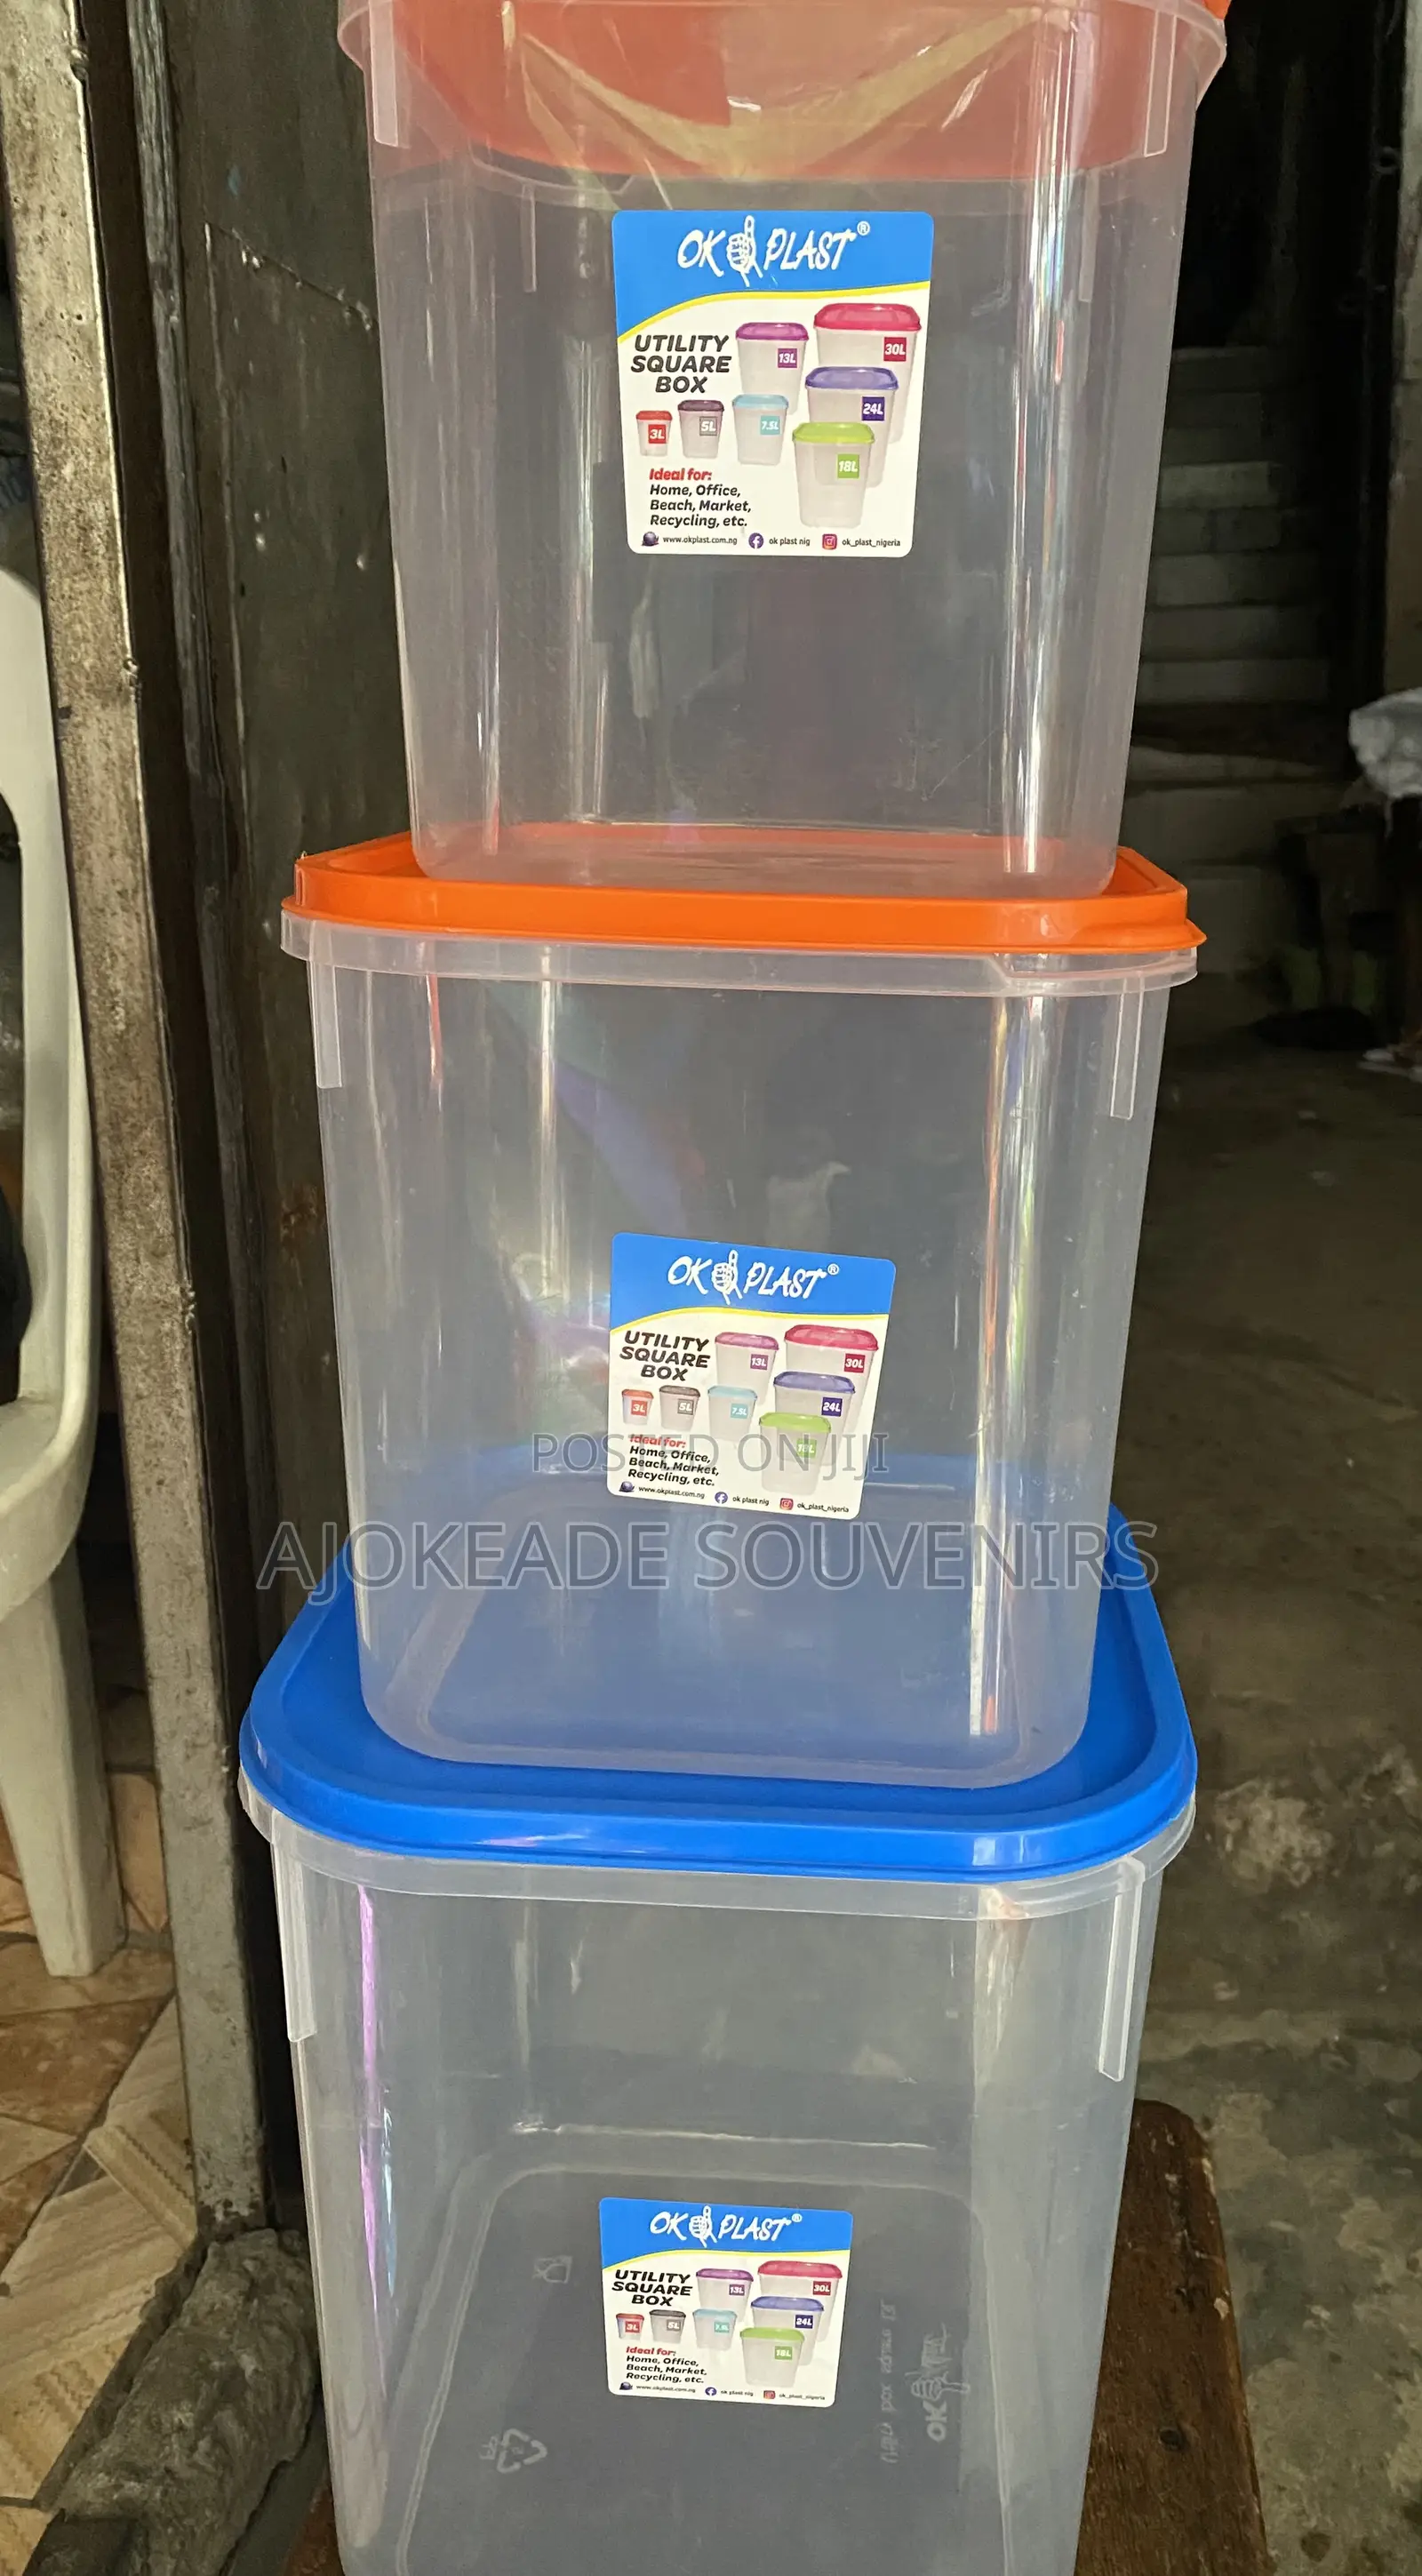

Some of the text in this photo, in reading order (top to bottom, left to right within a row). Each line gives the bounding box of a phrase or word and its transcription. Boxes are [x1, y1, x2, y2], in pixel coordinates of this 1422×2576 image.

[677, 229, 725, 277] OK
[634, 334, 729, 353] UTILITY
[884, 342, 907, 356] 30L
[630, 355, 731, 373] SQUARE
[778, 351, 797, 364] 13L
[655, 376, 708, 394] BOX
[862, 402, 884, 415] 24L
[700, 420, 717, 432] 5L
[761, 420, 779, 431] 7.5L
[649, 428, 666, 440] 3L
[838, 460, 859, 473] 18L
[649, 468, 712, 481] Ideal for:
[650, 484, 741, 498] Home, Office,
[650, 499, 752, 514] Beach, Market,
[650, 514, 747, 529] Recycling, etc.
[662, 534, 738, 546] www.okplast.com.ng
[769, 537, 811, 547] ok plast nig
[842, 537, 901, 548] ok_plast_nigeria
[667, 1255, 713, 1295] OK
[625, 1330, 710, 1352] UTILITY
[619, 1346, 711, 1368] SQUARE
[750, 1357, 767, 1367] 13L
[845, 1358, 864, 1369] 30L
[641, 1364, 688, 1381] BOX
[632, 1404, 645, 1413] 3L
[678, 1403, 692, 1412] 5L
[731, 1406, 747, 1416] 7.5L
[822, 1402, 842, 1412] 24L
[630, 1434, 686, 1449] Ideal for:
[629, 1446, 711, 1464] Home, Office,
[628, 1457, 720, 1476] Beach, Market,
[628, 1469, 715, 1487] Recycling, etc.
[732, 1495, 741, 1504] ok
[759, 1498, 770, 1507] nig
[649, 2211, 690, 2241] OK
[615, 2269, 691, 2284] UTILITY
[611, 2282, 692, 2296] SQUARE
[730, 2285, 745, 2294] 13L
[813, 2284, 831, 2293] 30L
[631, 2294, 674, 2307] BOX
[626, 2323, 639, 2332] 3L
[795, 2317, 813, 2326] 24L
[626, 2346, 676, 2356] Ideal for:
[626, 2356, 699, 2367] Home, Office,
[626, 2364, 707, 2376] Beach, Market,
[626, 2372, 704, 2384] Recycling, etc.
